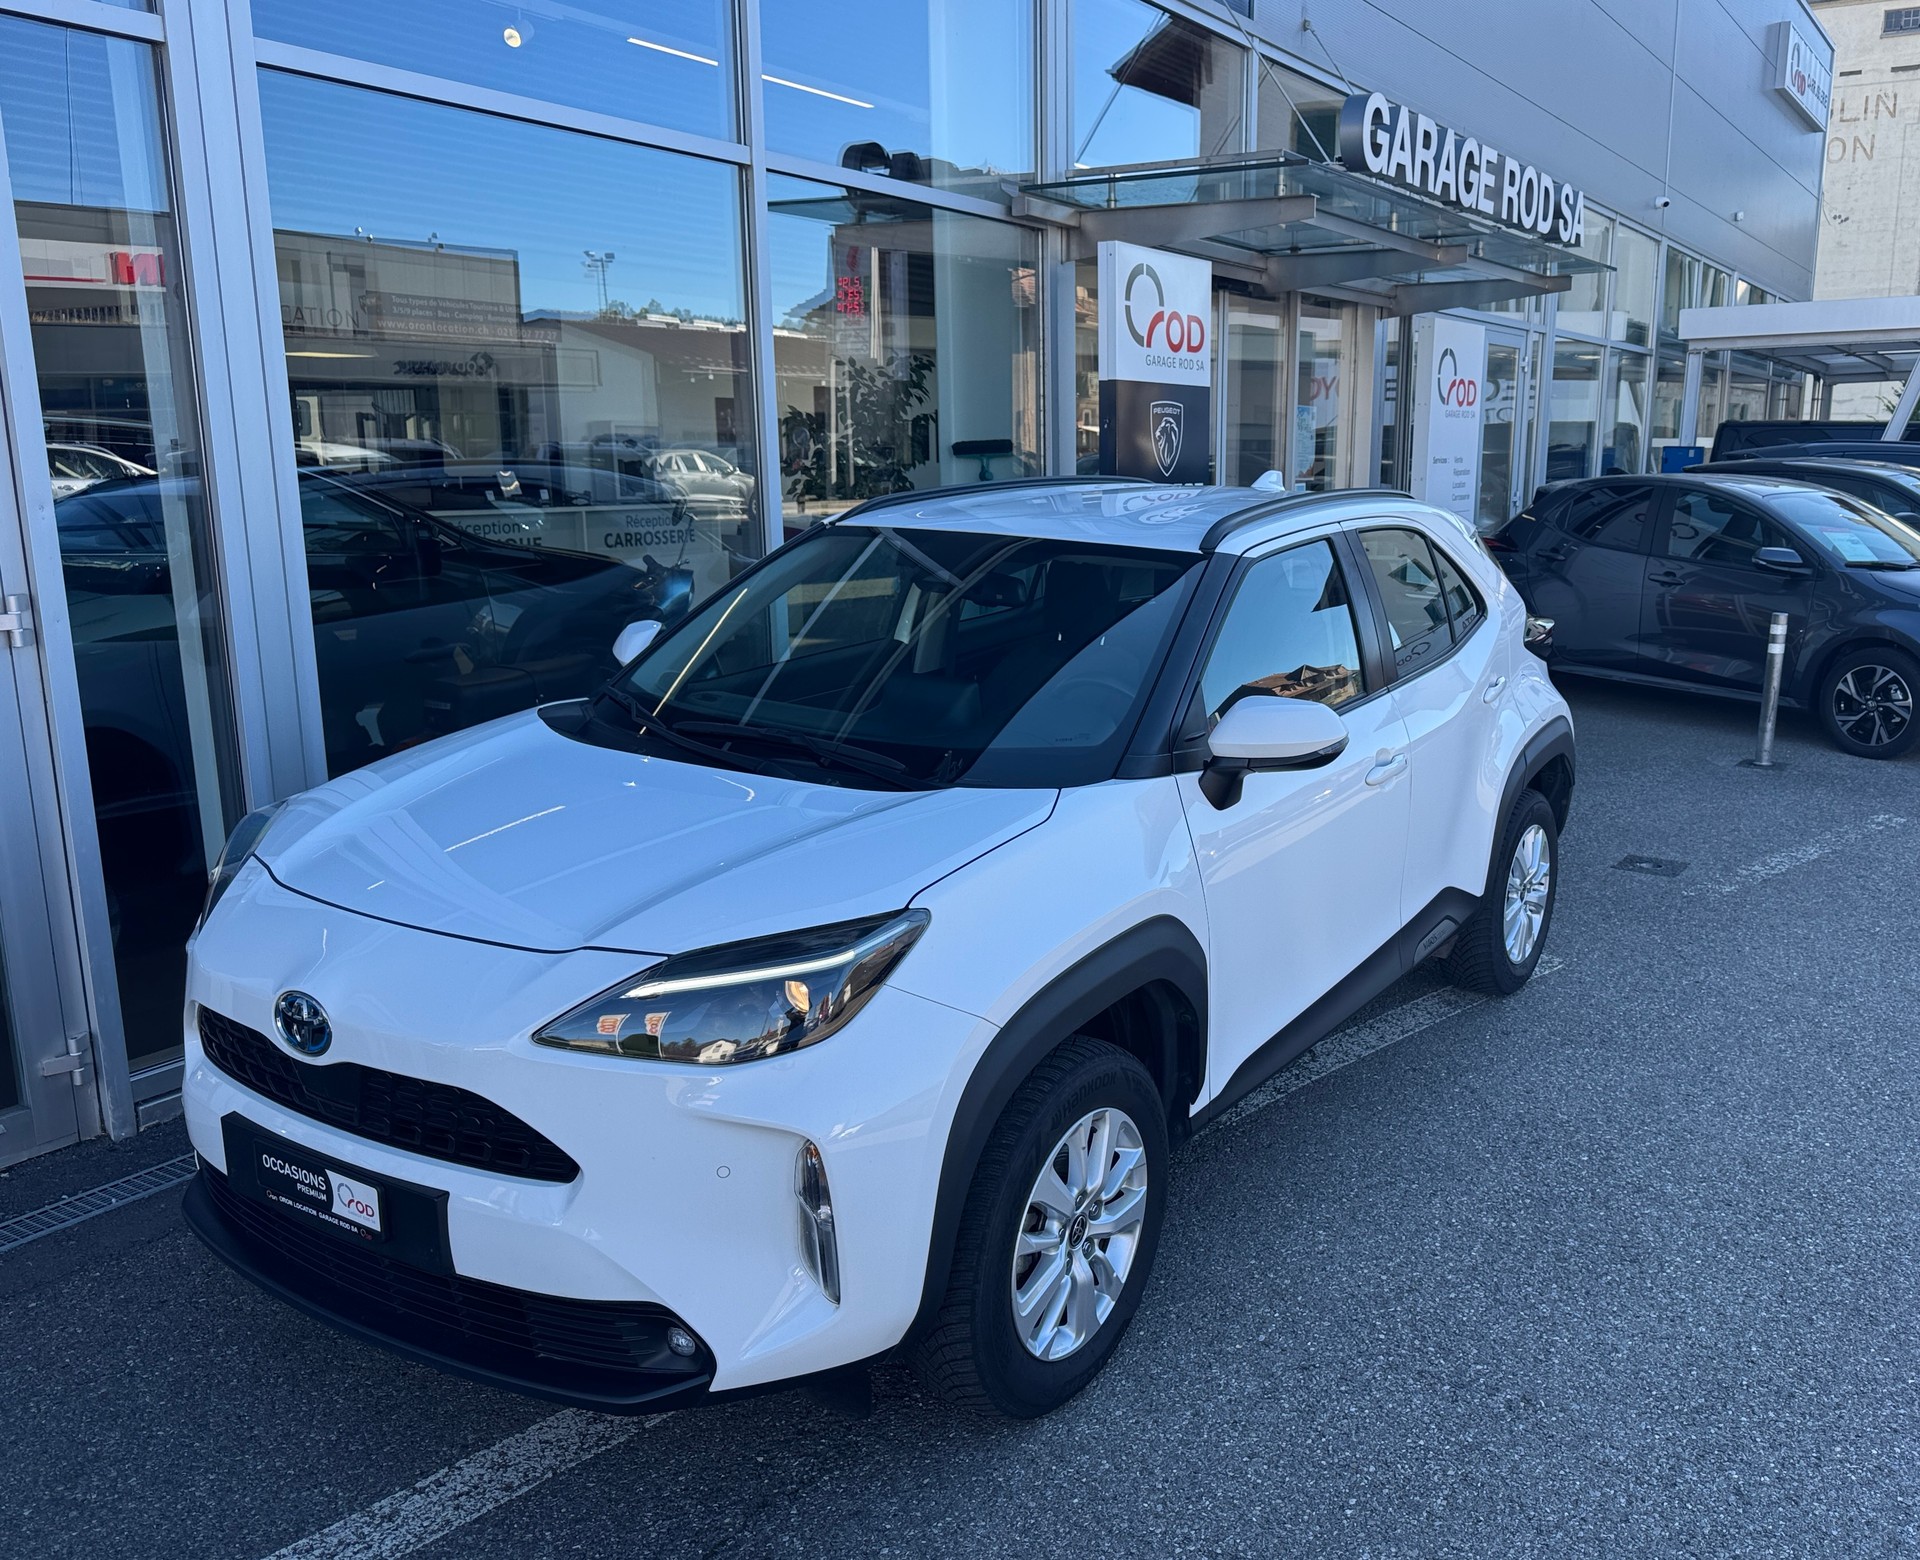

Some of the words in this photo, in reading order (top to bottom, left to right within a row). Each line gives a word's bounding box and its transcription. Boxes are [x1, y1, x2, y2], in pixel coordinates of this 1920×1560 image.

[1363, 92, 1498, 215] GARAGE
[1501, 155, 1554, 234] ROD
[1559, 183, 1584, 247] SA
[1145, 354, 1177, 369] GARAGE
[1179, 357, 1194, 371] ROD
[1196, 358, 1205, 372] SA
[1153, 406, 1181, 416] PEUGEOT
[262, 1154, 327, 1190] OCCASIONS
[297, 1183, 327, 1202] PREMIUM
[293, 1201, 317, 1216] LOCATION
[318, 1212, 340, 1226] GARAGE
[339, 1220, 351, 1231] ROD
